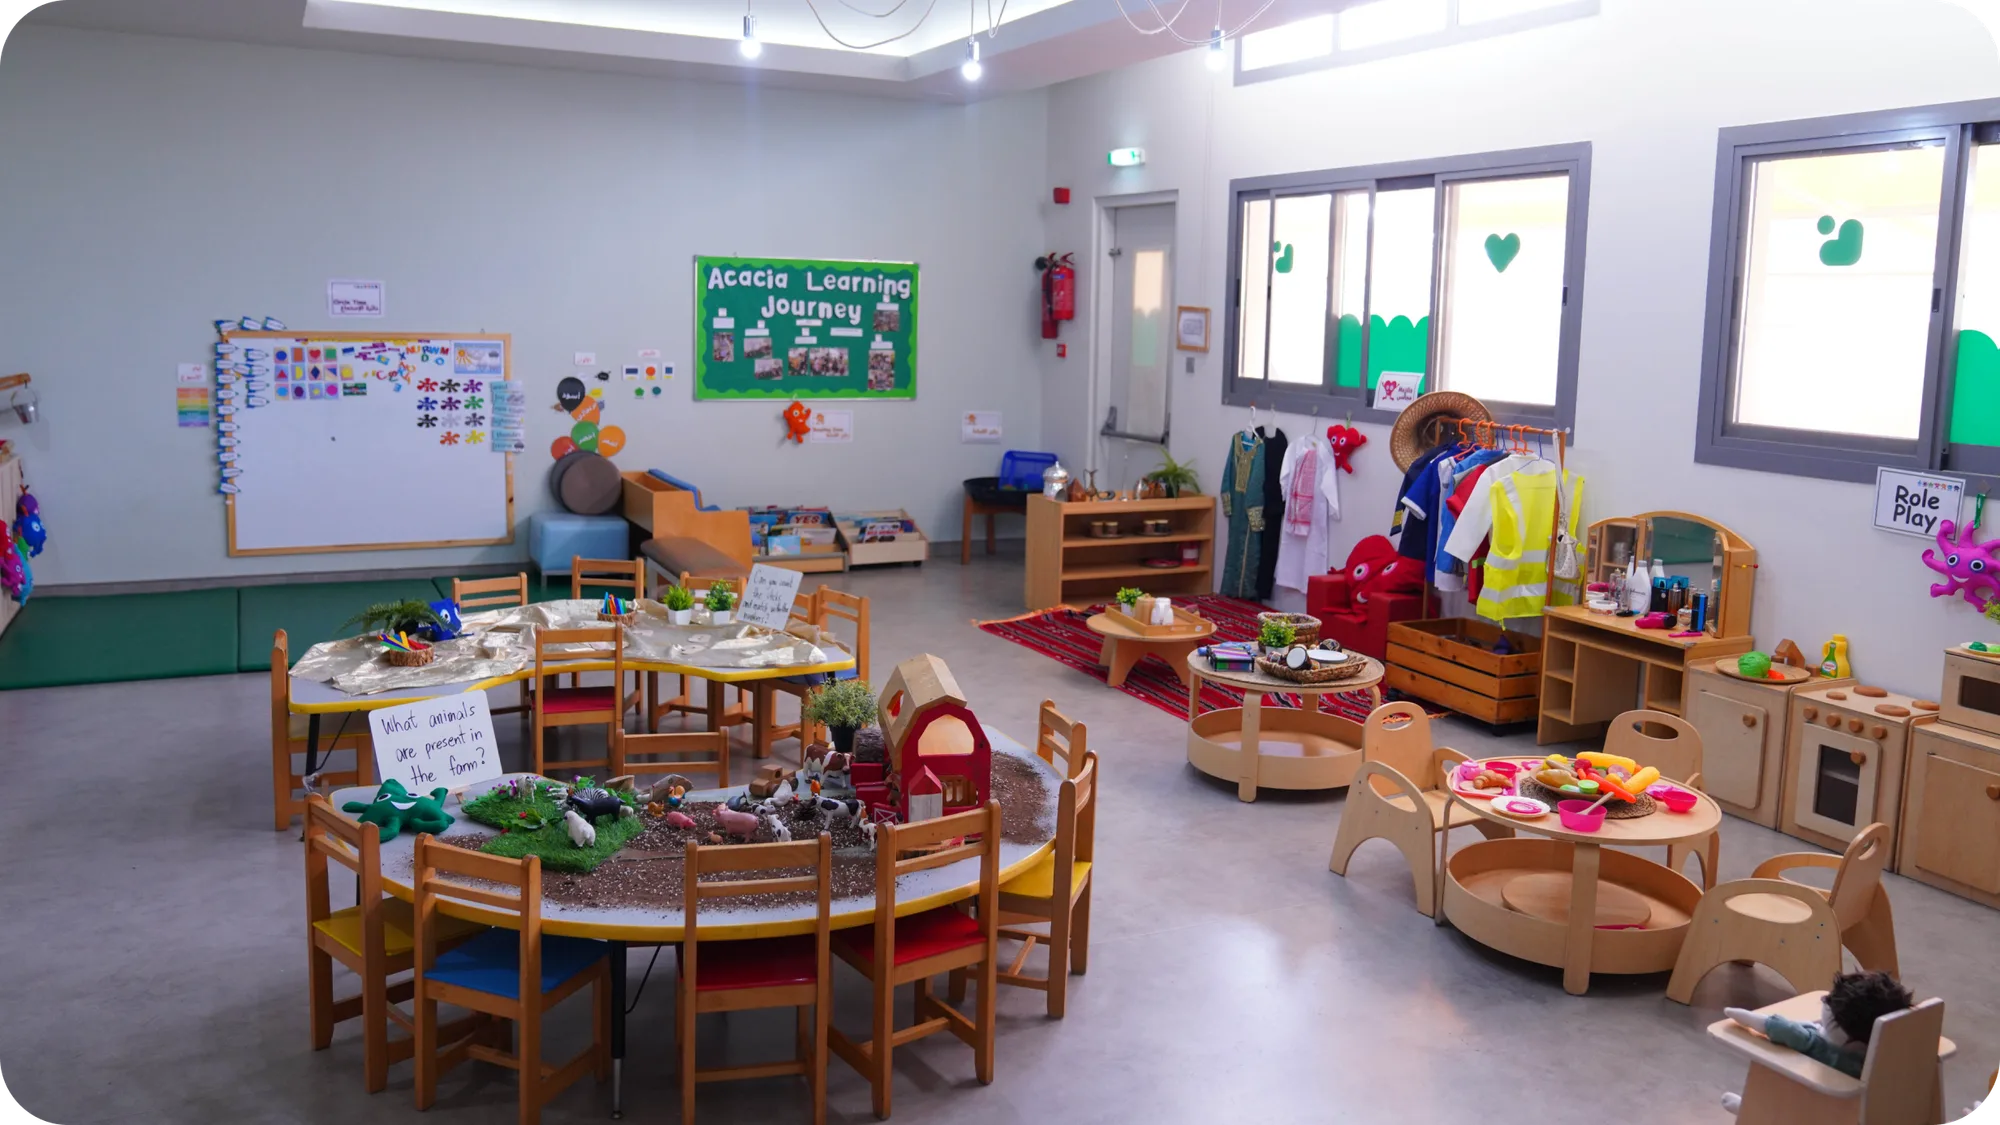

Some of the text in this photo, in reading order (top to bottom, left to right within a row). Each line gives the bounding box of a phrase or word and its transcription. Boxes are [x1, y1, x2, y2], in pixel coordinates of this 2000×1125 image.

[708, 267, 912, 299] Acacia Learning
[761, 295, 862, 326] Journey
[562, 391, 581, 400] أسود
[1895, 485, 1940, 510] Role
[794, 514, 822, 524] YES
[1892, 504, 1938, 534] Play
[754, 569, 766, 584] Can
[381, 701, 476, 735] What animals
[396, 724, 483, 762] are present in
[410, 765, 437, 786] the
